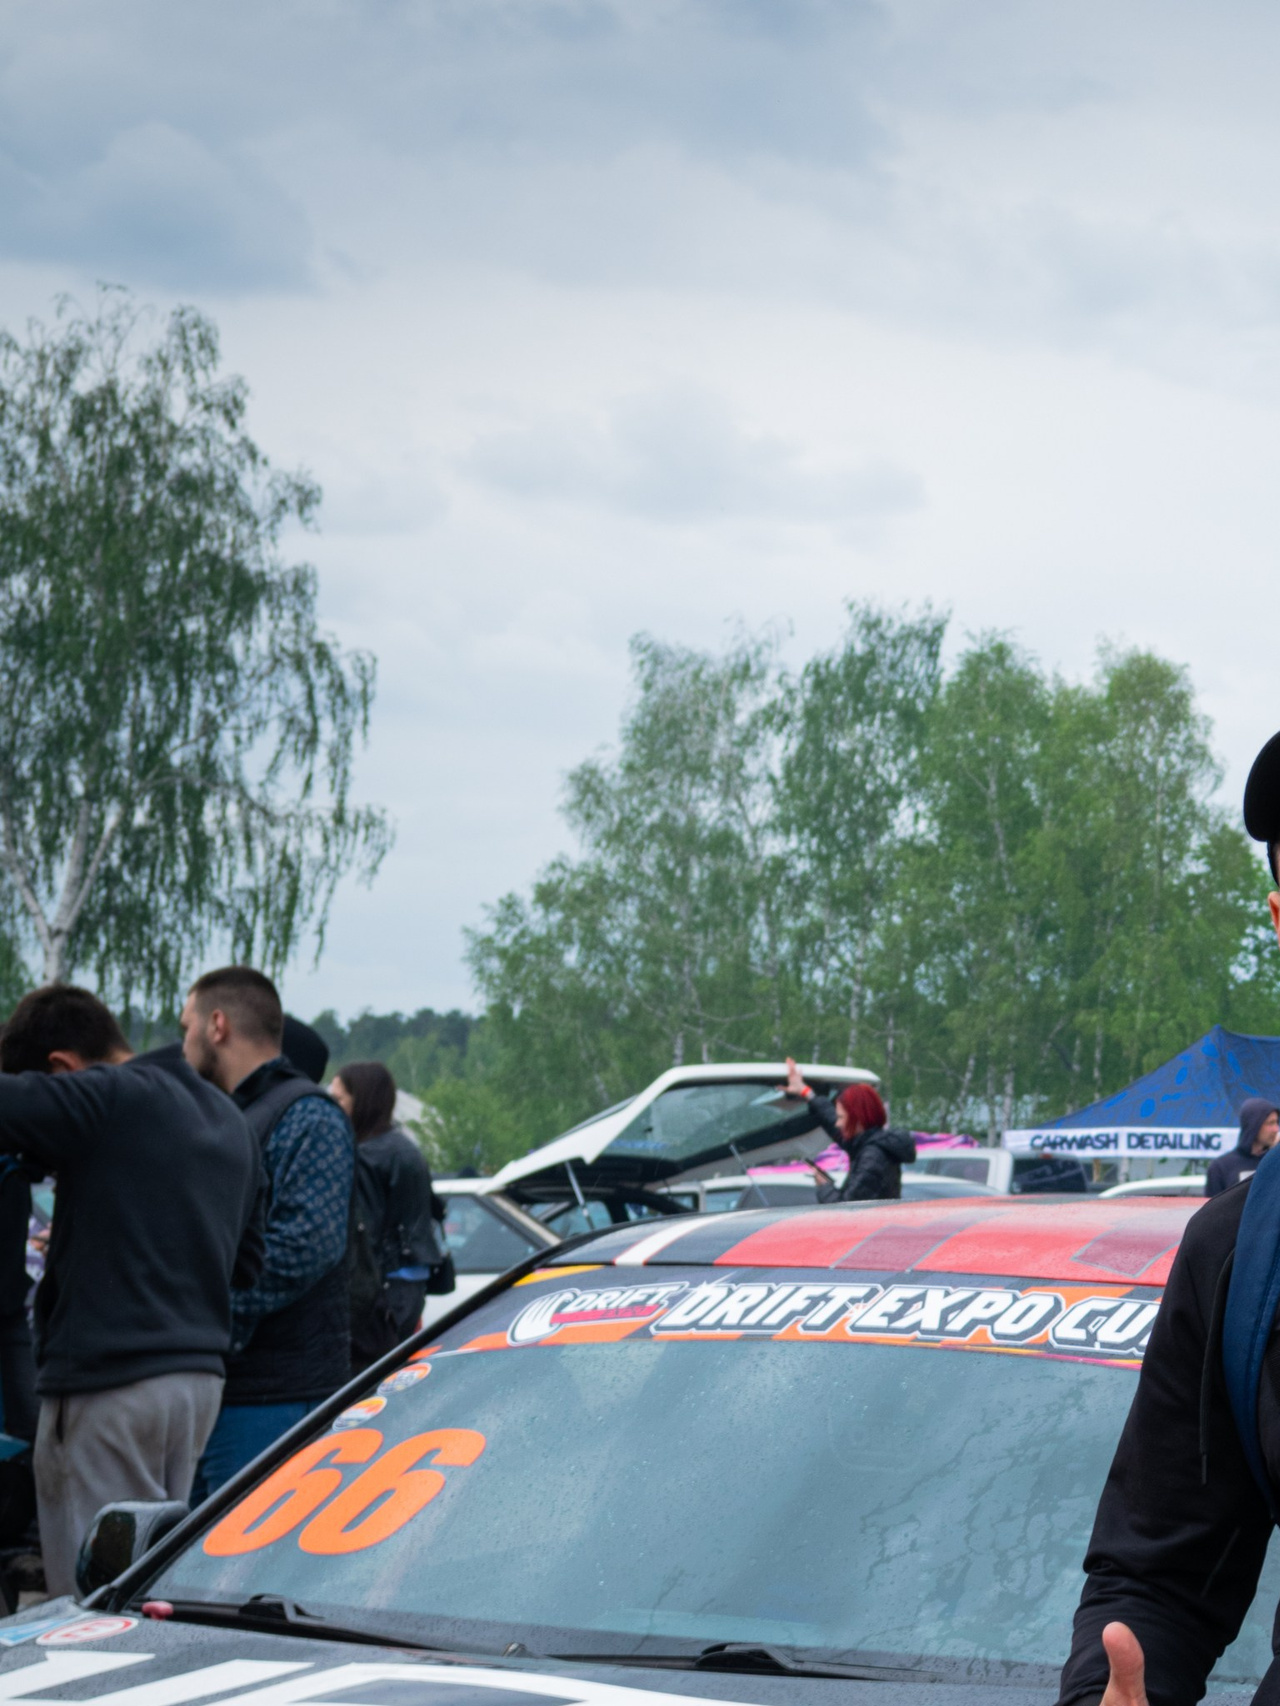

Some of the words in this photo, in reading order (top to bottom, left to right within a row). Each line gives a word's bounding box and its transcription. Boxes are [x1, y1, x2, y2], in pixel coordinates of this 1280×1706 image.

[1029, 1132, 1119, 1151] CARWASH
[1126, 1132, 1222, 1151] DETAILING
[561, 1285, 681, 1313] DRIFT
[658, 1284, 872, 1328] DRIFT
[853, 1286, 1055, 1335] EXPO
[1054, 1298, 1161, 1347] CU
[203, 1427, 487, 1557] 66
